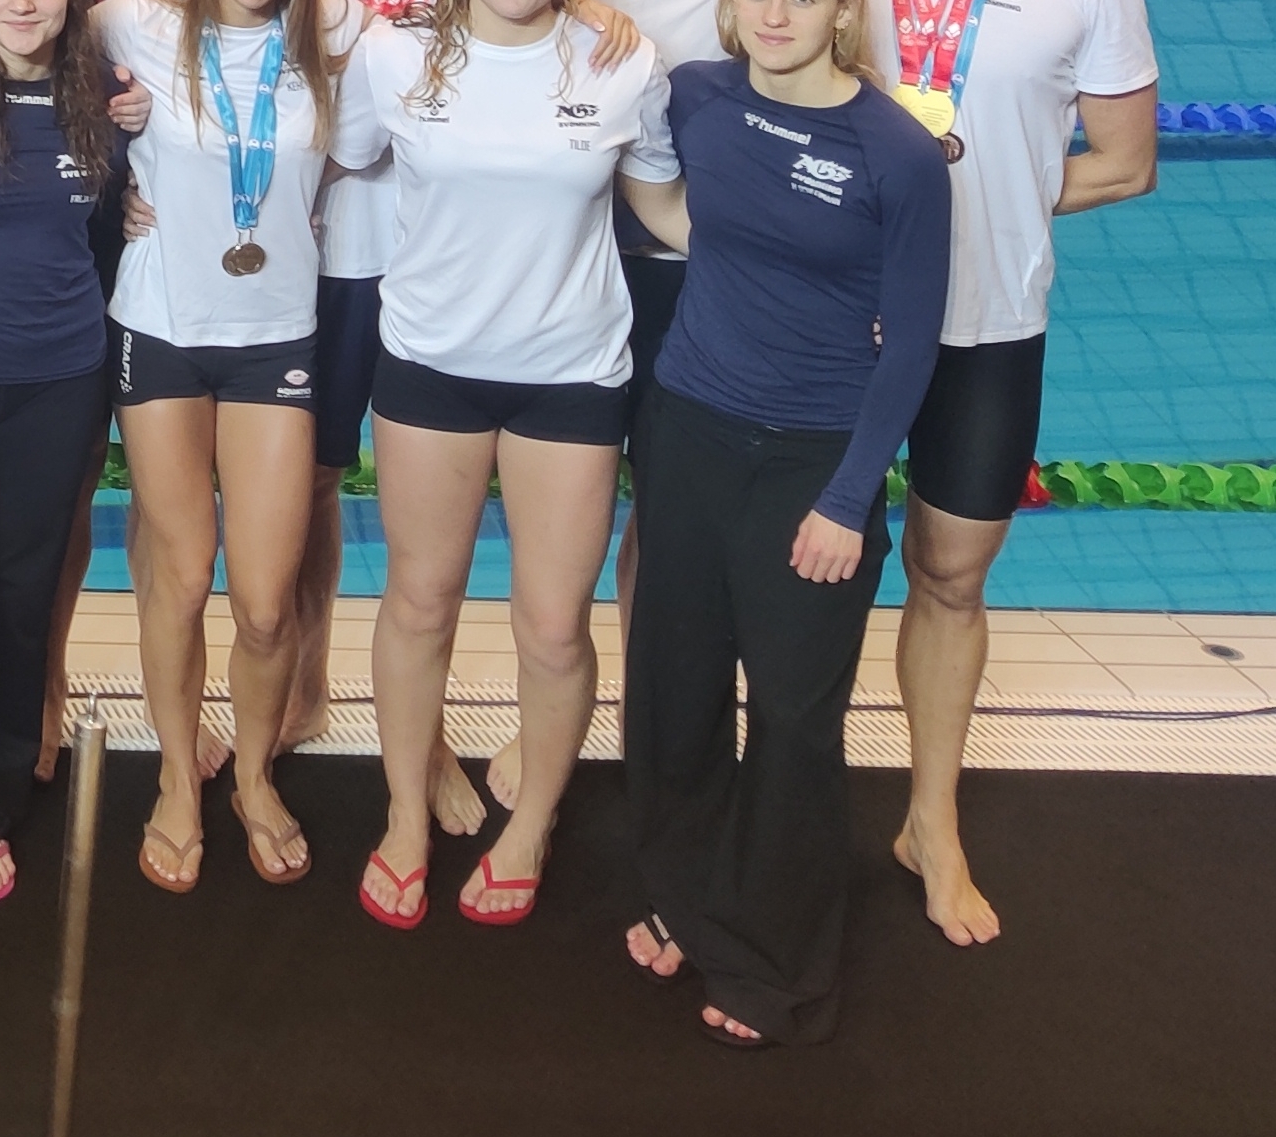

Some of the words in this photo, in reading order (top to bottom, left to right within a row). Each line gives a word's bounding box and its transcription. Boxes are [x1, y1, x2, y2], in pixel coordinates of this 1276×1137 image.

[569, 138, 591, 152] TILDE
[758, 118, 812, 146] hummel
[121, 331, 133, 383] CRAFT
